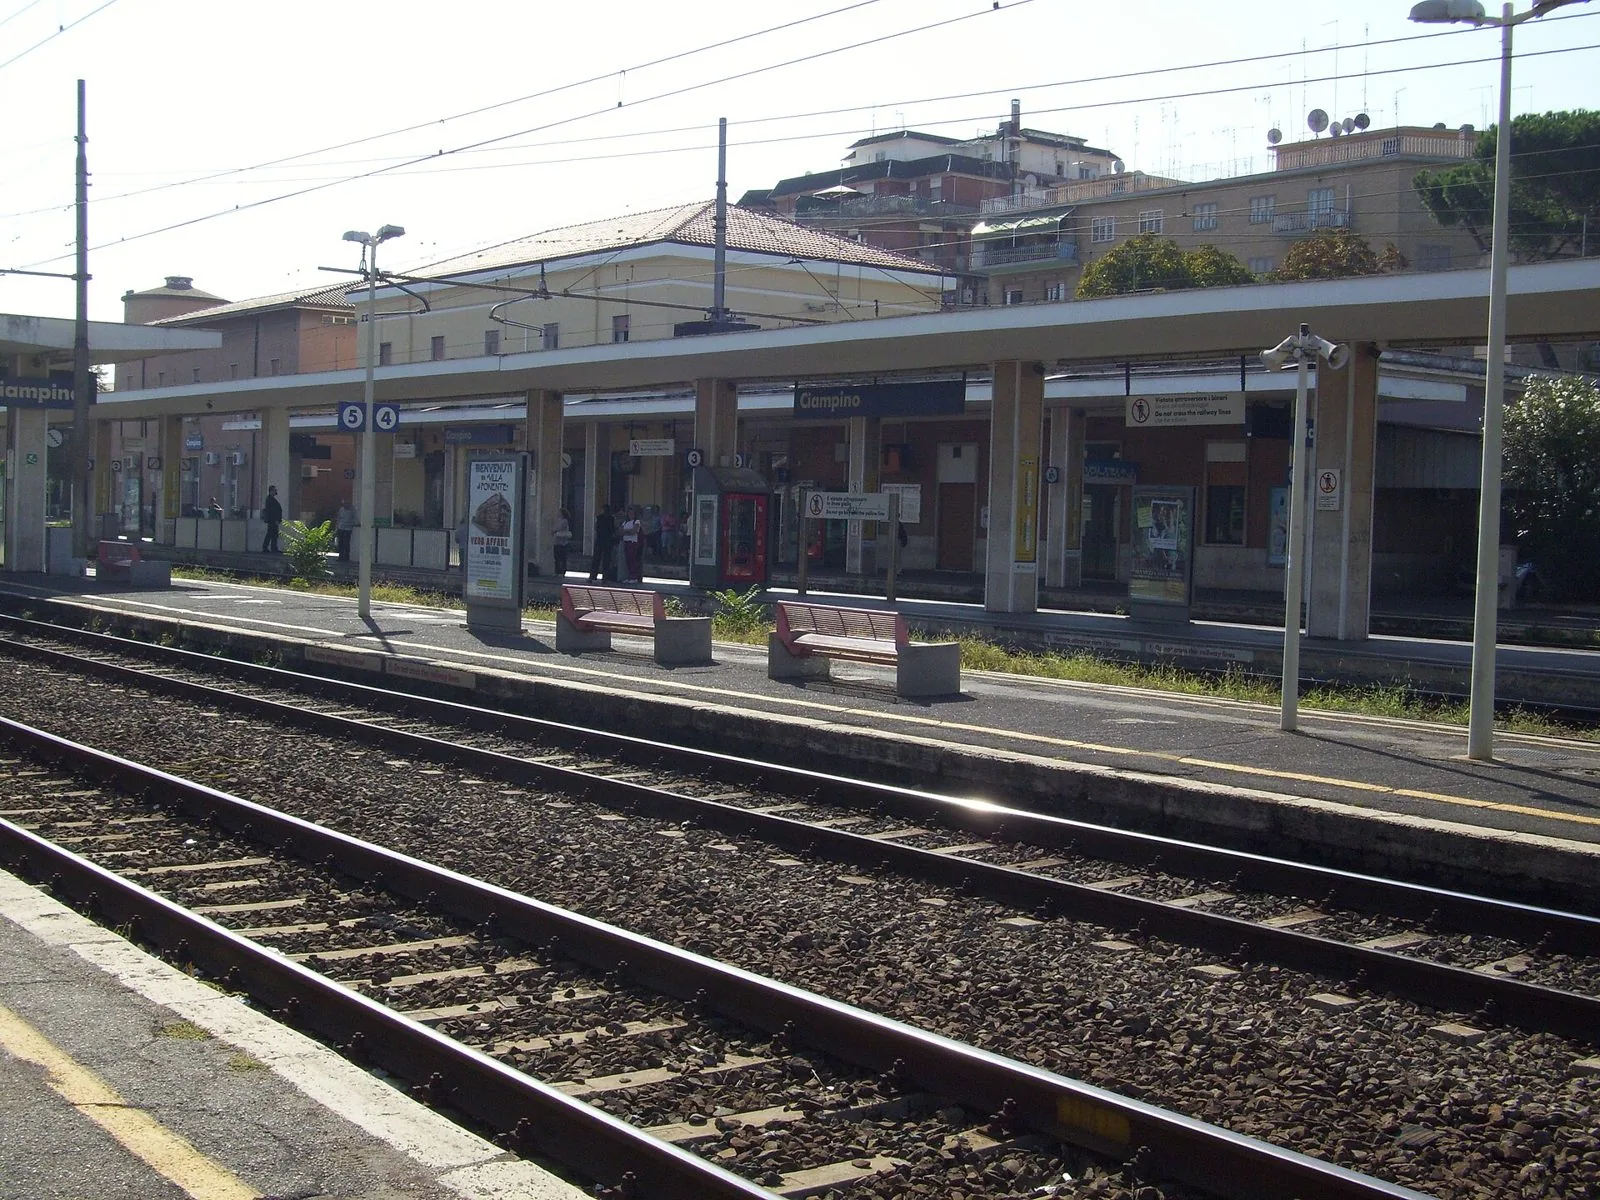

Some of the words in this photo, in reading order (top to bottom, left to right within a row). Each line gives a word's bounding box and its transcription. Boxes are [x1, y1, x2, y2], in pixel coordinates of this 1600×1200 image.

[0, 381, 75, 403] iampin
[800, 391, 861, 412] Ciampino
[348, 409, 358, 424] 5
[381, 411, 392, 426] 4
[691, 453, 698, 463] 3
[475, 463, 513, 473] BENVENUTI
